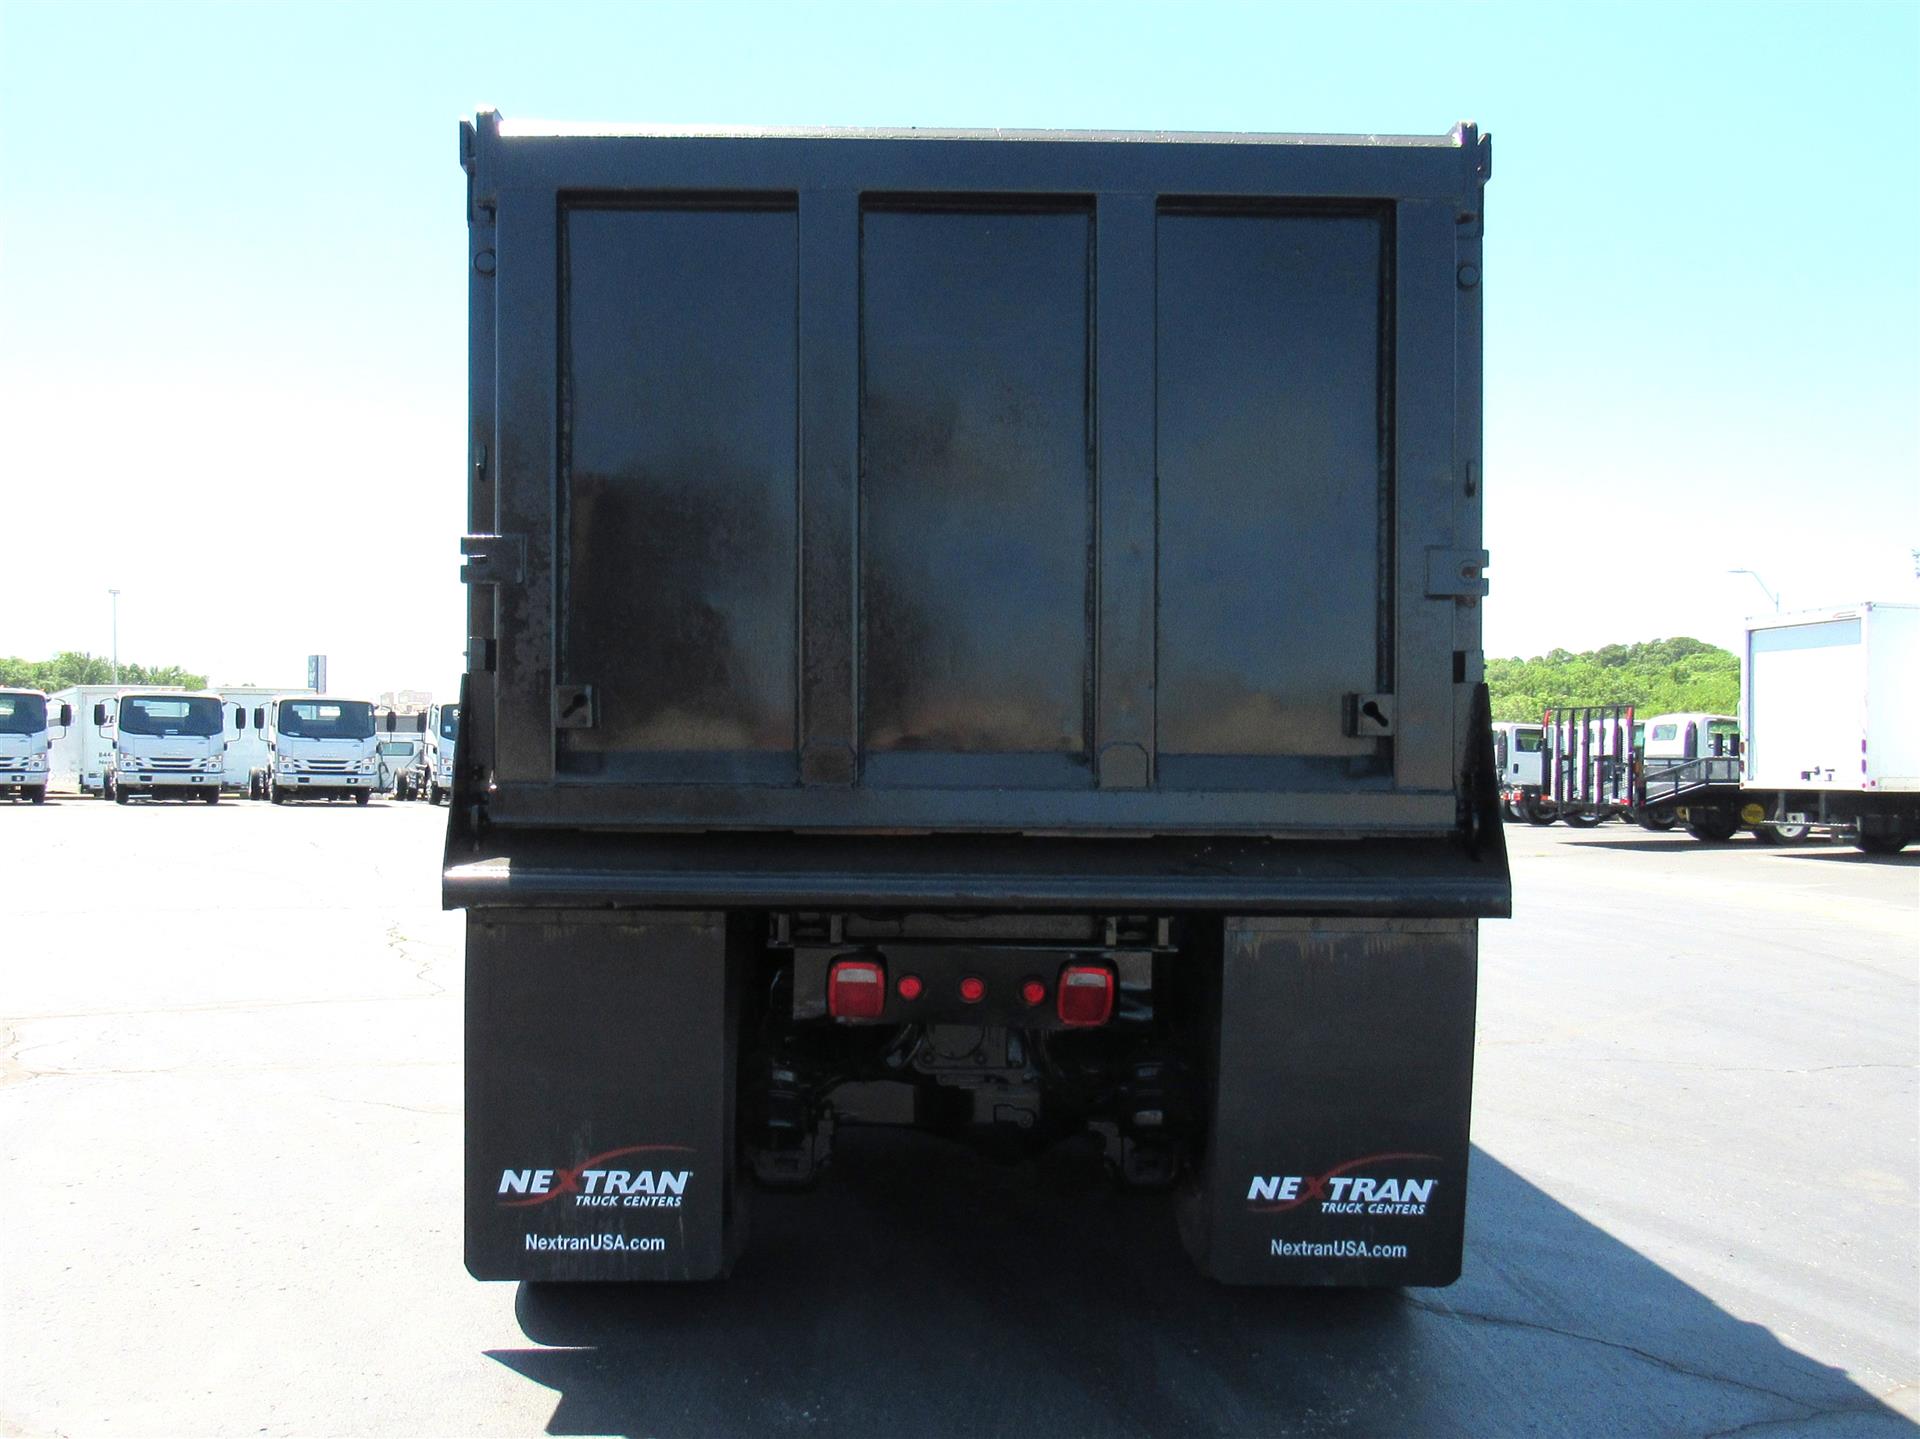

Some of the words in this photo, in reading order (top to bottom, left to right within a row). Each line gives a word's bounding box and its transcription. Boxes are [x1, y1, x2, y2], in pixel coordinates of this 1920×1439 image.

[498, 1169, 690, 1195] NEXTRAN
[1247, 1176, 1434, 1203] NEXTRAN
[575, 1195, 619, 1207] TRUCK
[623, 1196, 682, 1208] CENTERS
[1321, 1202, 1364, 1214] TRUCK
[1368, 1203, 1426, 1215] CENTERS
[525, 1233, 666, 1251] NextranUSA.com
[1270, 1239, 1408, 1258] NextranUSA.com
